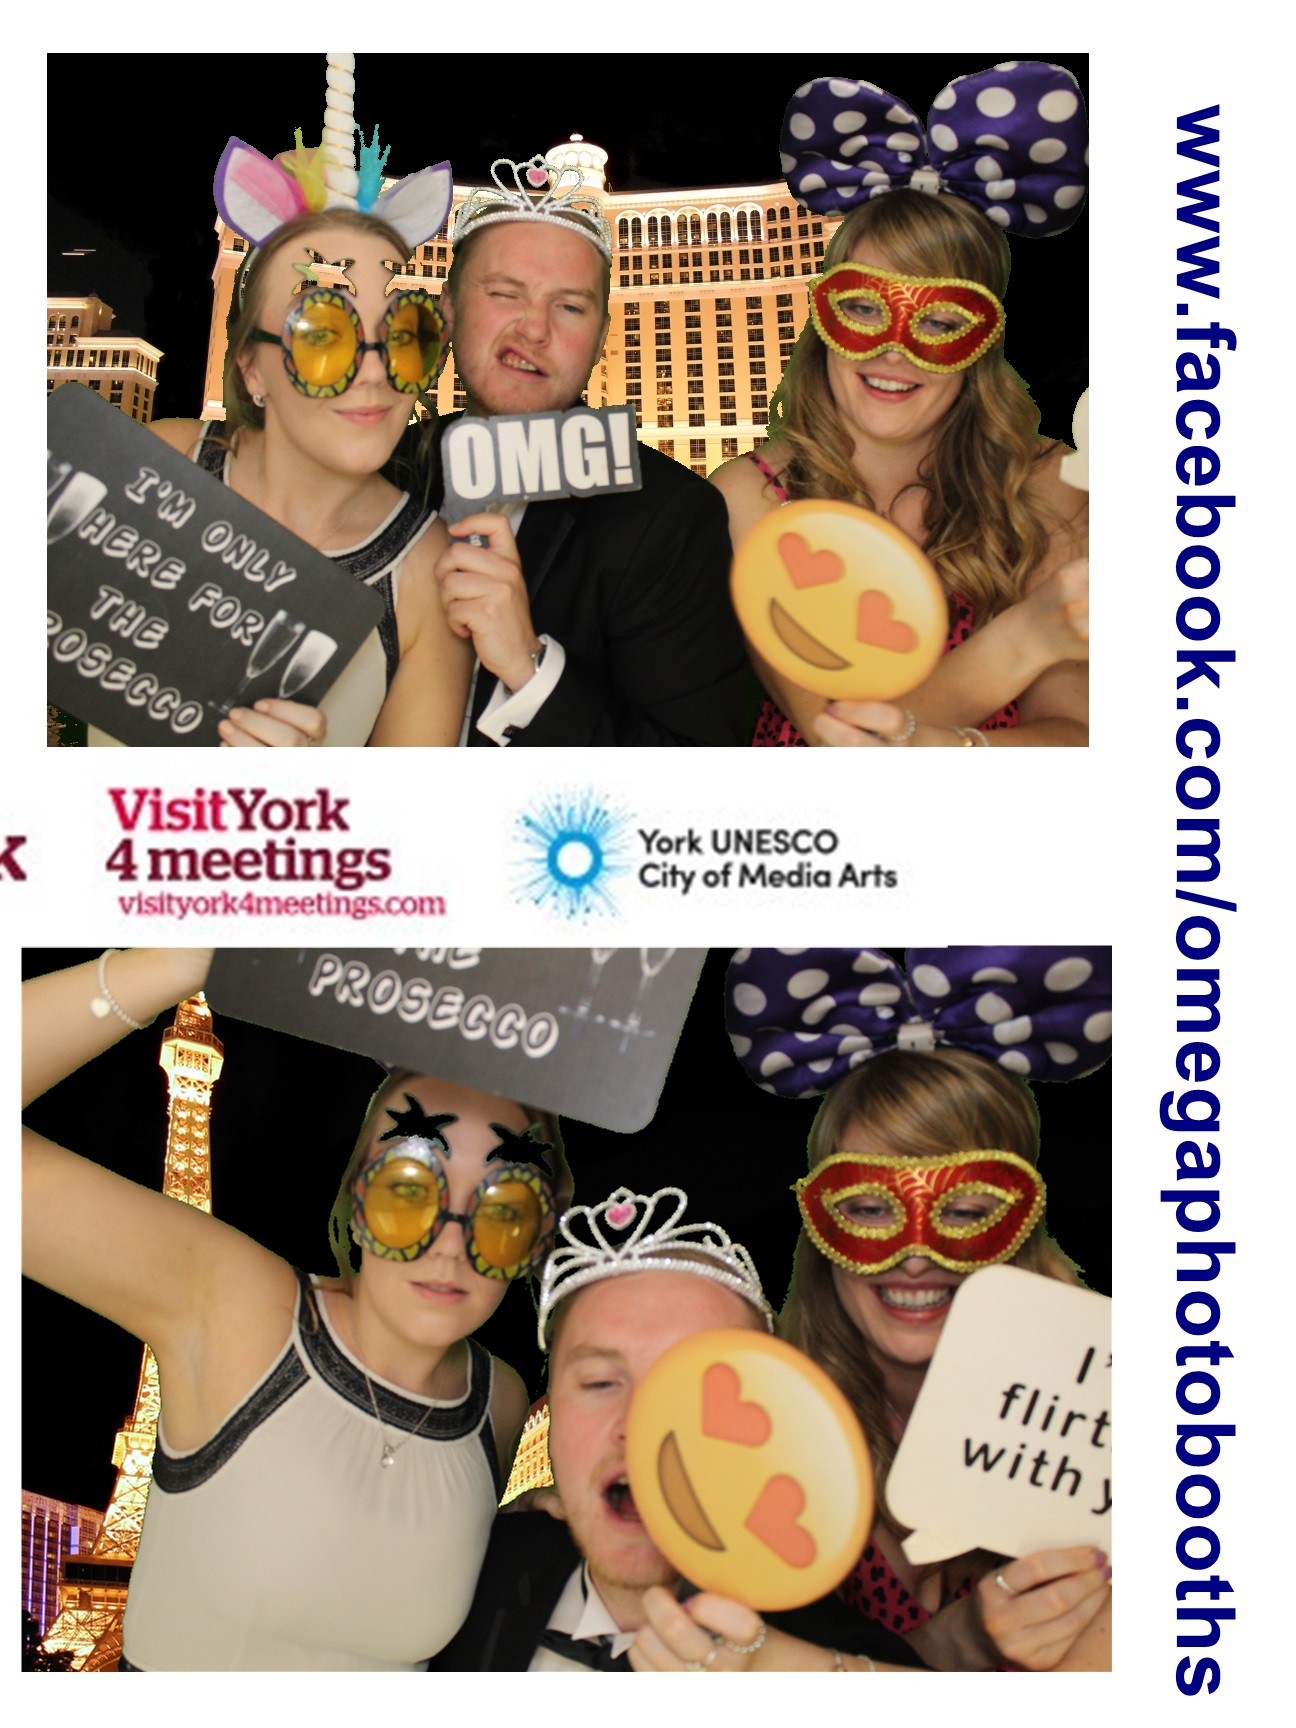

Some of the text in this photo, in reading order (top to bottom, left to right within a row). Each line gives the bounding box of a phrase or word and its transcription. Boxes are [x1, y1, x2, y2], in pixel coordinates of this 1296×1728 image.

[448, 412, 634, 500] OMG!
[124, 466, 297, 592] I'M ONLY
[78, 507, 265, 647] HERE FOR
[90, 584, 169, 649] THE
[308, 953, 559, 1059] PROSECCO
[1000, 1383, 1112, 1448] flirt
[964, 1438, 1082, 1497] with
